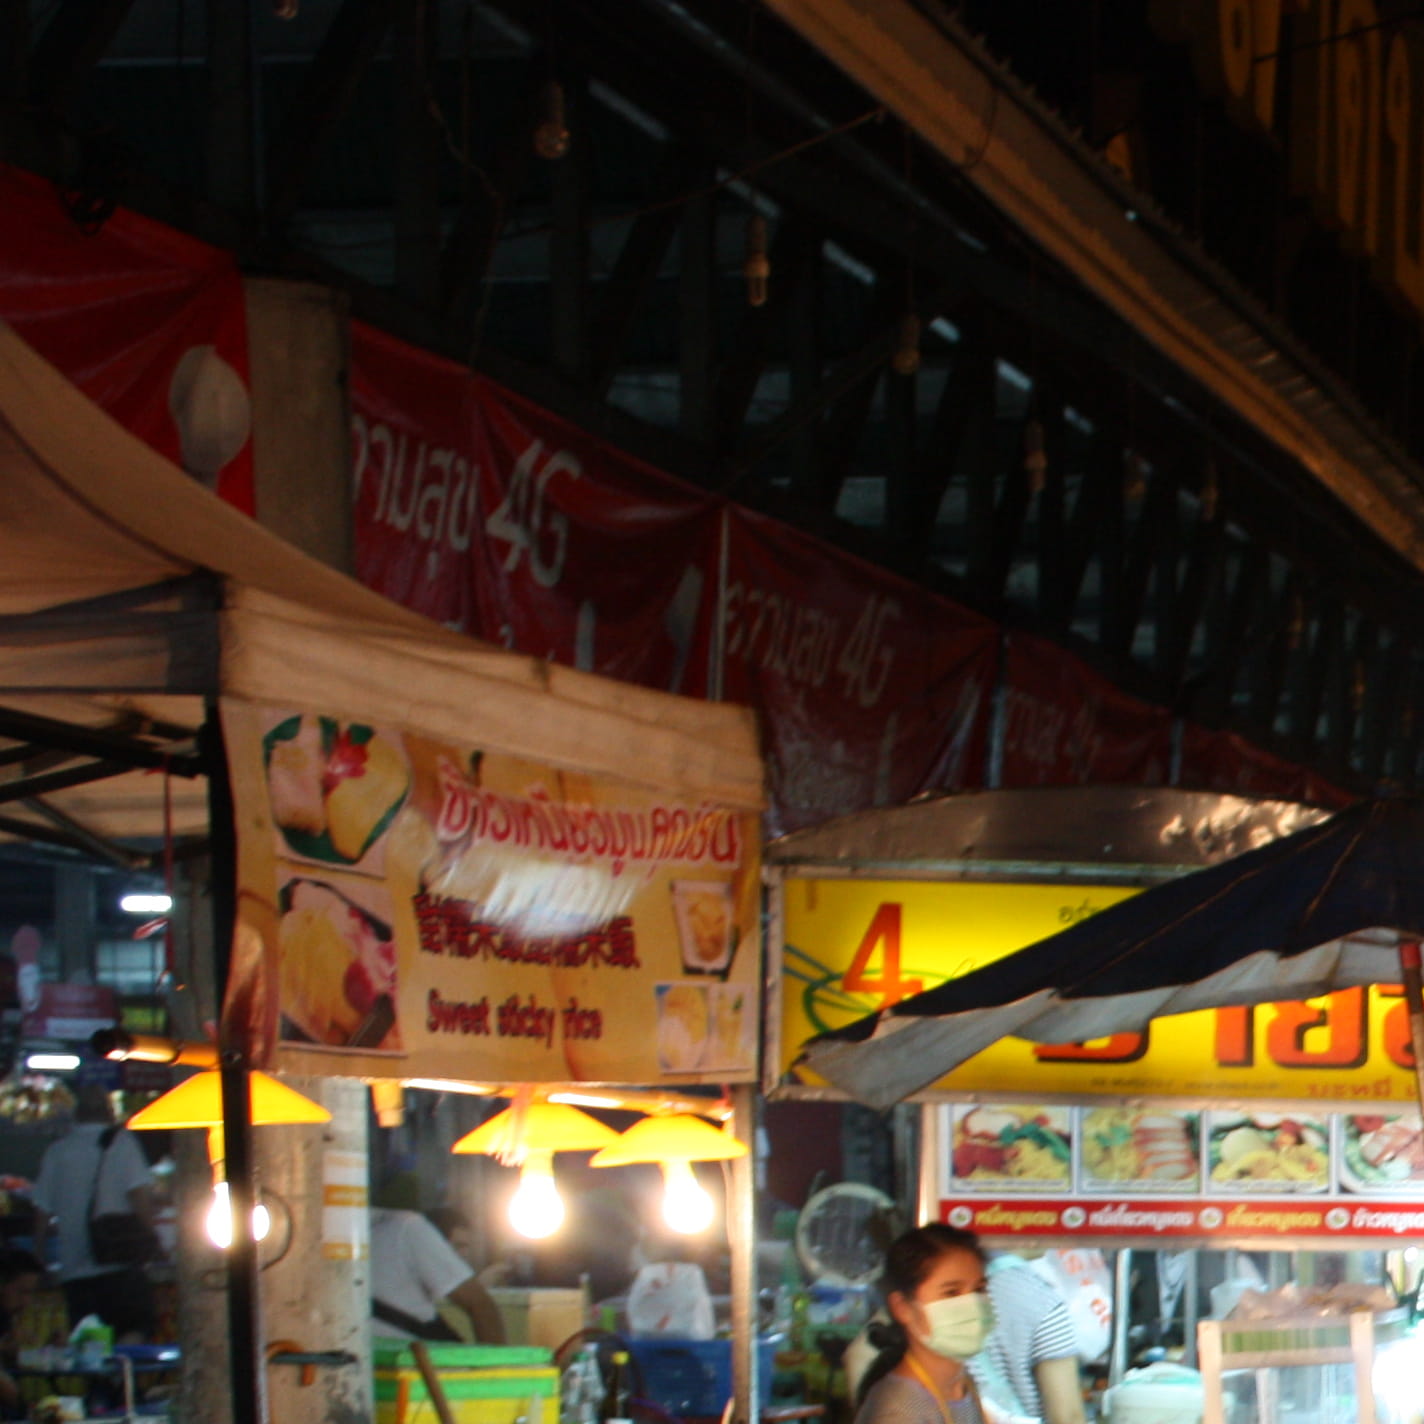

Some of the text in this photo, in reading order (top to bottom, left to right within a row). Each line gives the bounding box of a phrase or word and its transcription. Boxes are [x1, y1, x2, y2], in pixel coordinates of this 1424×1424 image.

[485, 438, 584, 588] 4G
[837, 592, 901, 708] 4G
[841, 902, 923, 1011] 4
[427, 987, 603, 1049] Sweet sticky rice
